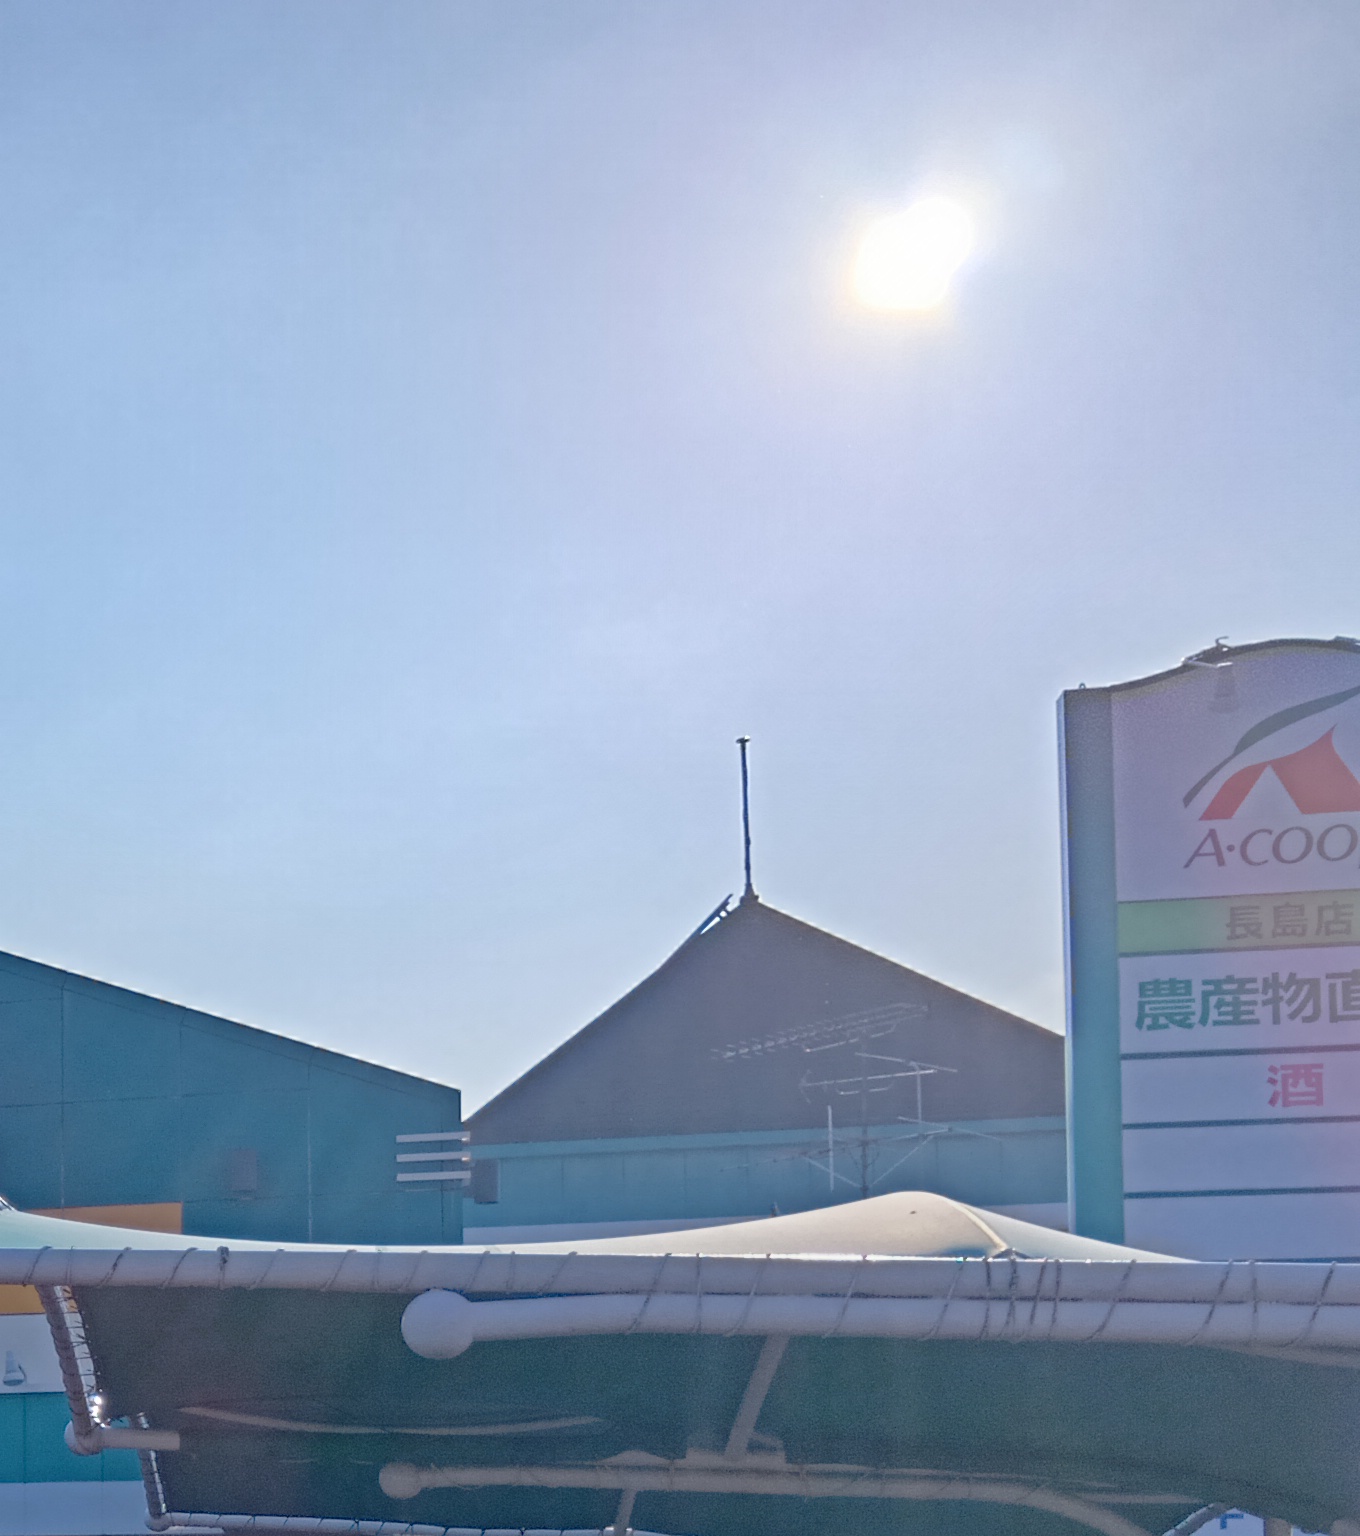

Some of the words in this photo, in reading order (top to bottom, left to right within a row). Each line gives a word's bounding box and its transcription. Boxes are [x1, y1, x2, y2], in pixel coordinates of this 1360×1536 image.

[1183, 823, 1360, 870] A·COO
[1225, 901, 1354, 941] 長島店
[1266, 1063, 1324, 1108] 酒
